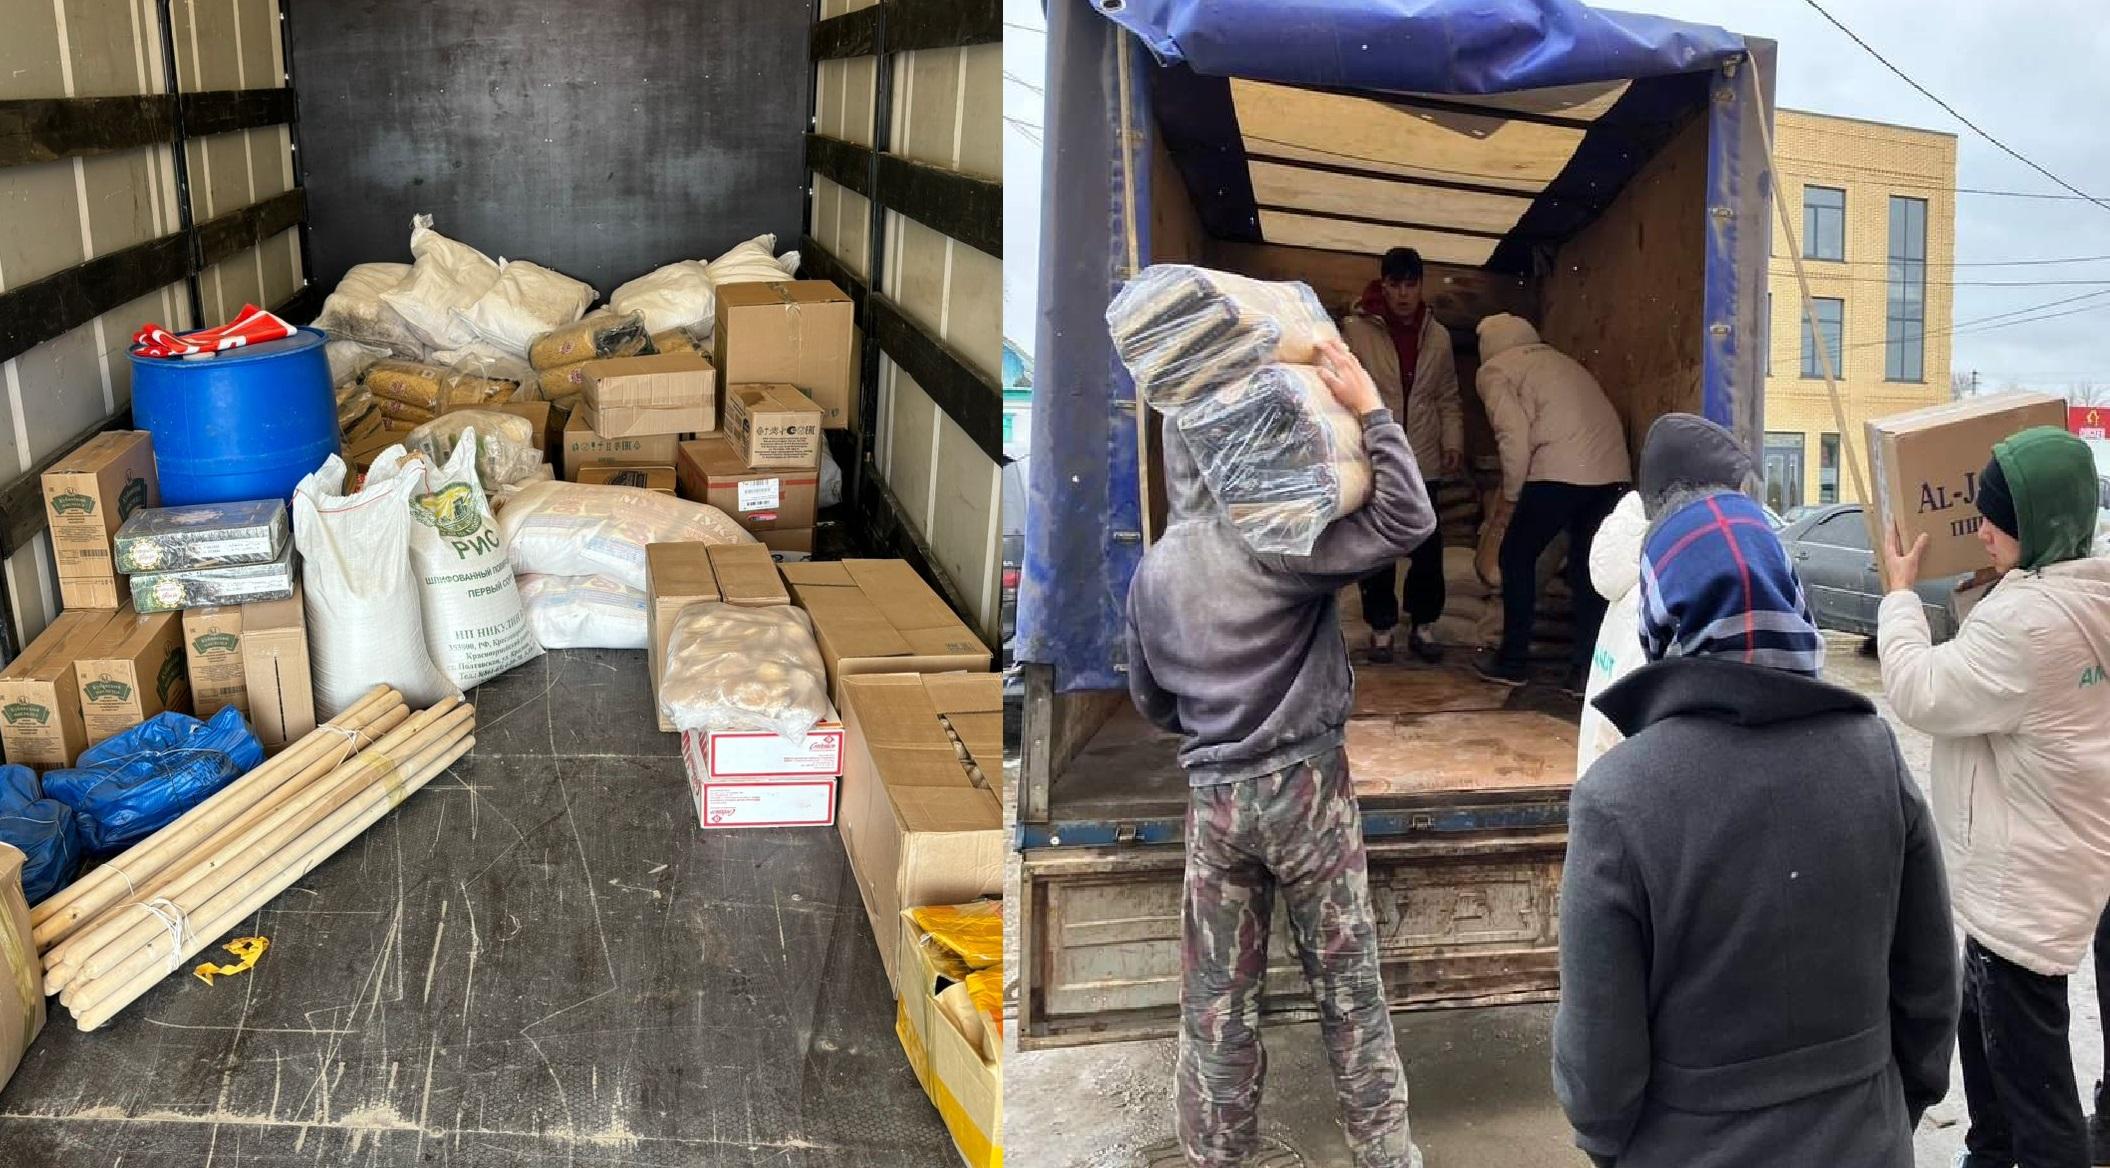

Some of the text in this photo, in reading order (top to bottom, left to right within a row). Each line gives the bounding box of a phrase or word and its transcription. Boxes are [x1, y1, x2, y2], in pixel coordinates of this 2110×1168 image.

[1918, 472, 1976, 513] AL-J
[451, 528, 500, 560] РИС
[425, 566, 493, 585] ШЛИФОВАННЫЙ
[467, 580, 503, 598] ПЕРВЫЙ
[455, 629, 474, 640] ИП
